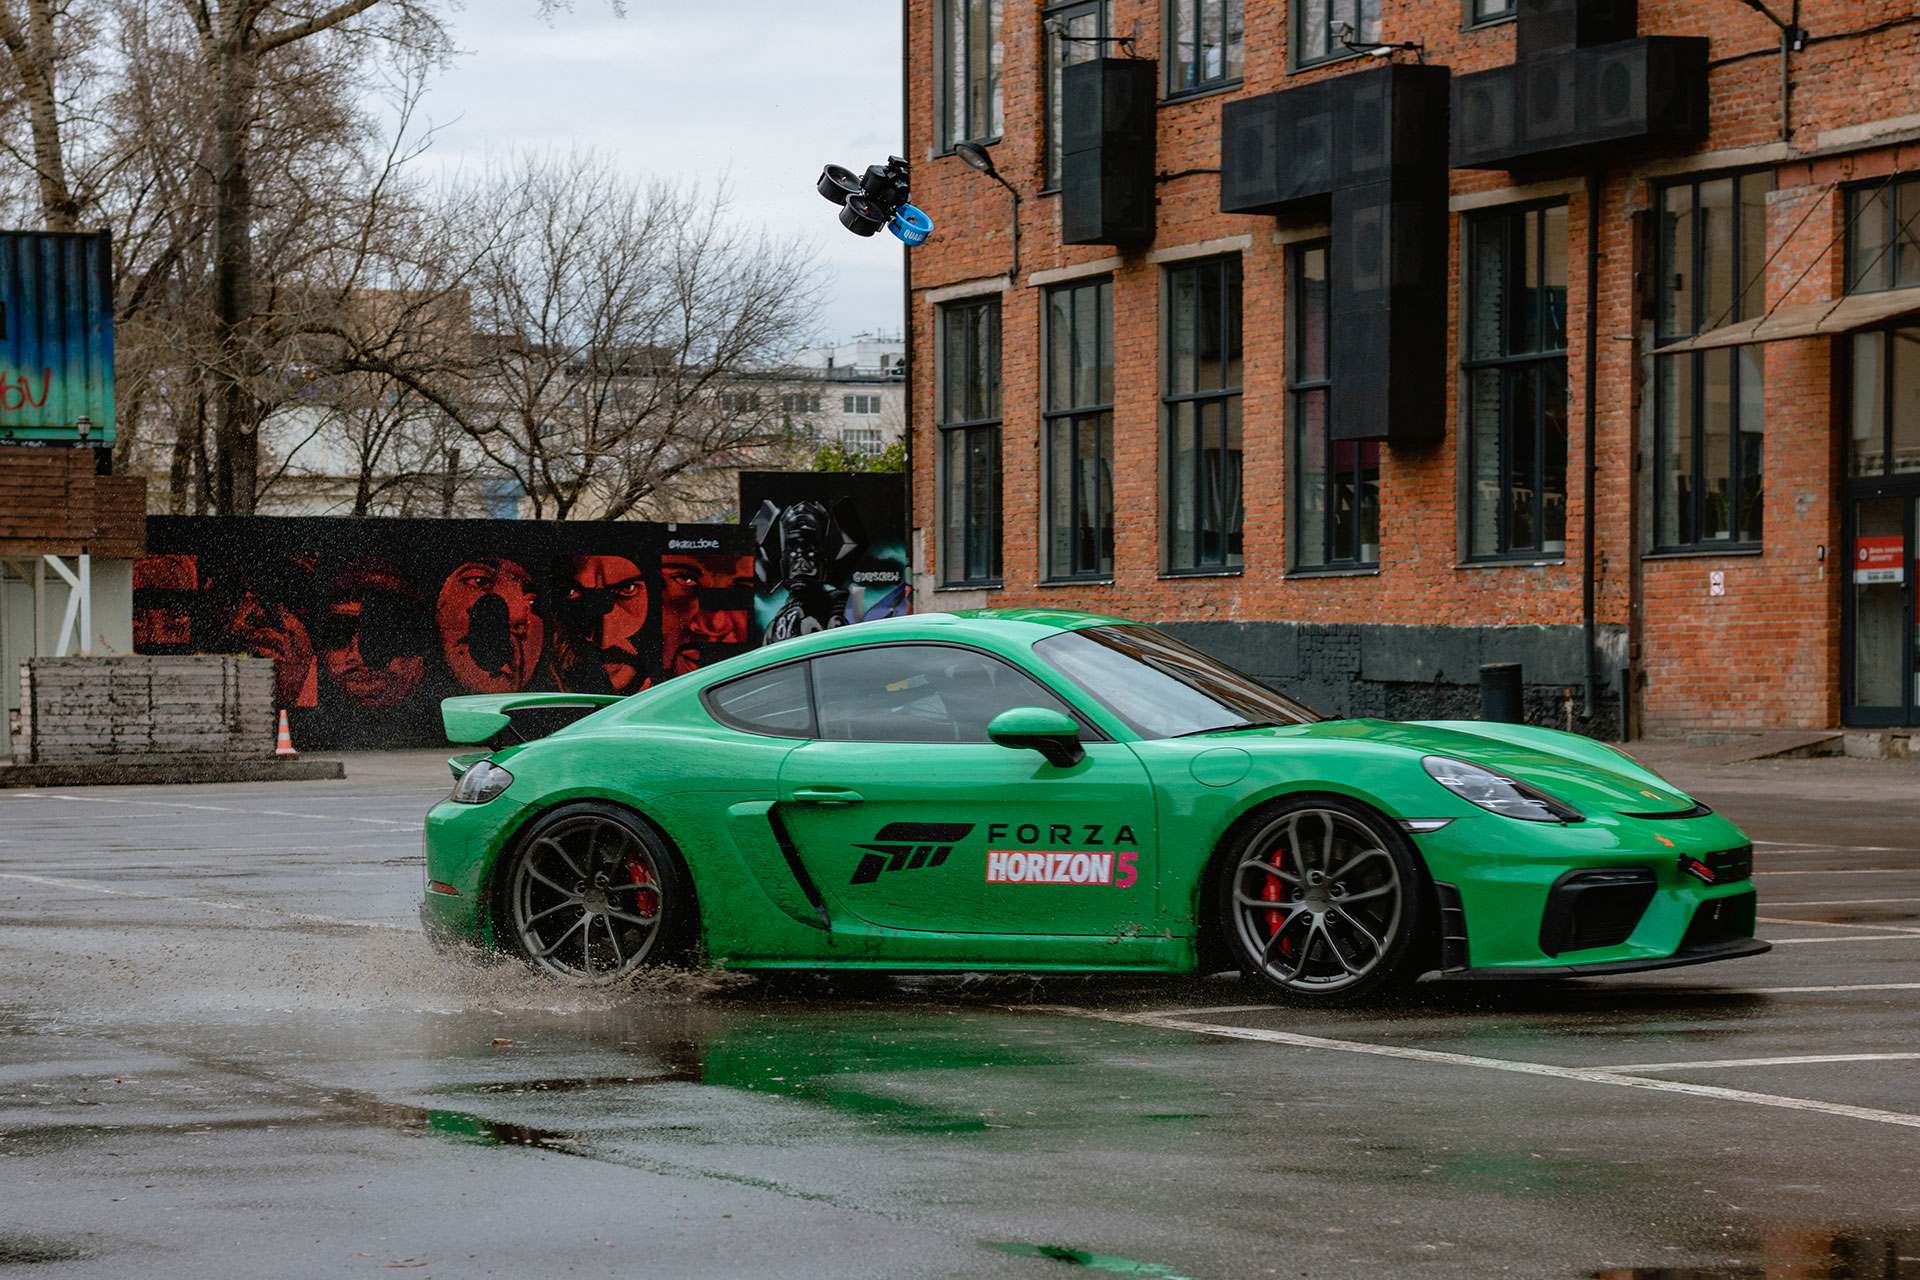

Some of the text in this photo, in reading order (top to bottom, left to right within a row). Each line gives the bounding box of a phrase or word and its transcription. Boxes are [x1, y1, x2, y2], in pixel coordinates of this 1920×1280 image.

[988, 823, 1138, 845] FORZA
[988, 851, 1139, 888] HORIZON 5
